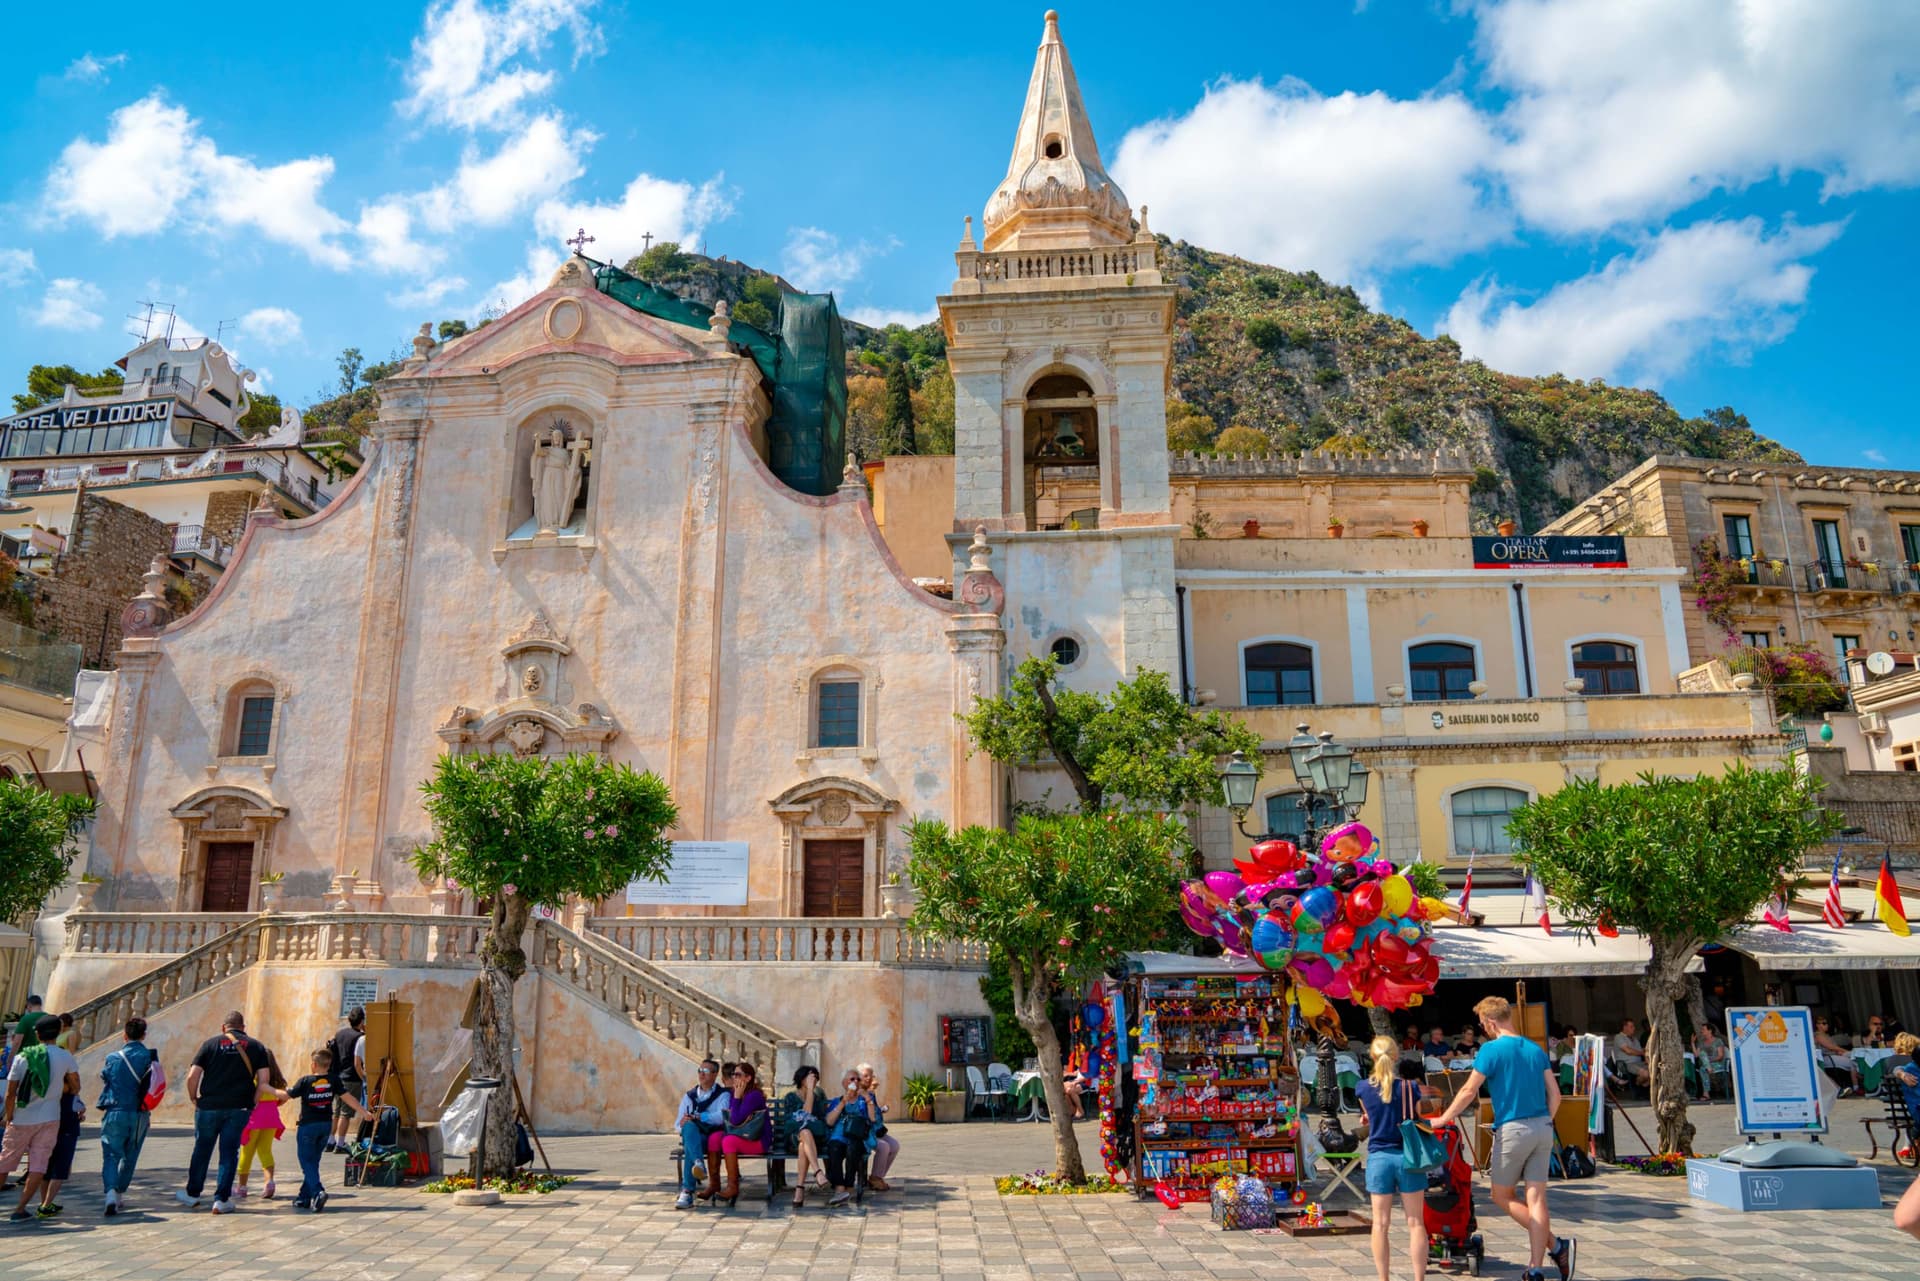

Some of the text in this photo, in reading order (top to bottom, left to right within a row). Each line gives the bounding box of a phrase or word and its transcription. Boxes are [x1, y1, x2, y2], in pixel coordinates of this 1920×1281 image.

[9, 414, 61, 430] HOTEL
[1505, 537, 1548, 546] ITALIAN
[1491, 542, 1550, 560] OPERA
[1448, 712, 1540, 725] SALESIANI DON BOSCO
